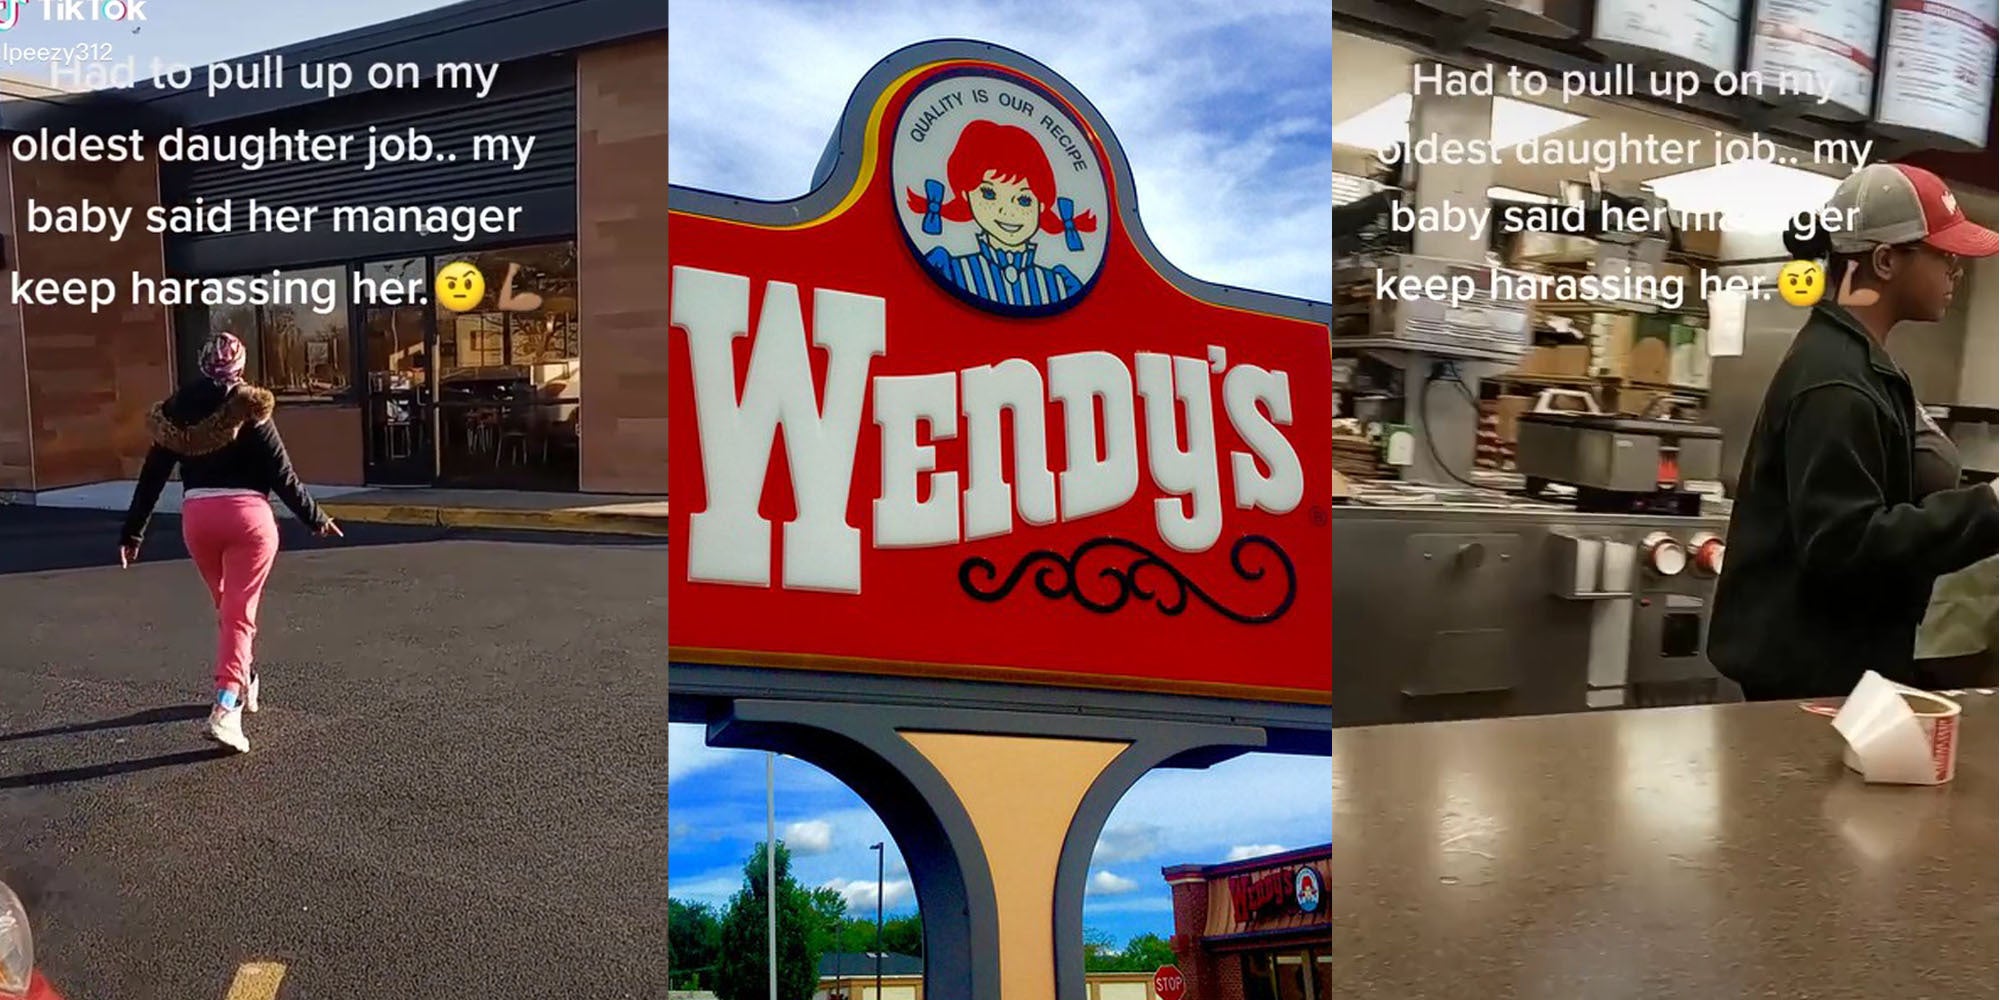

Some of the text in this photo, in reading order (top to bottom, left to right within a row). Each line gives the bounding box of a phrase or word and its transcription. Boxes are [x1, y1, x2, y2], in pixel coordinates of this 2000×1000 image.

[910, 89, 1088, 172] QUALITY IS OUR RECIPE
[671, 264, 1304, 596] Wendy's
[1155, 975, 1183, 992] STOP
